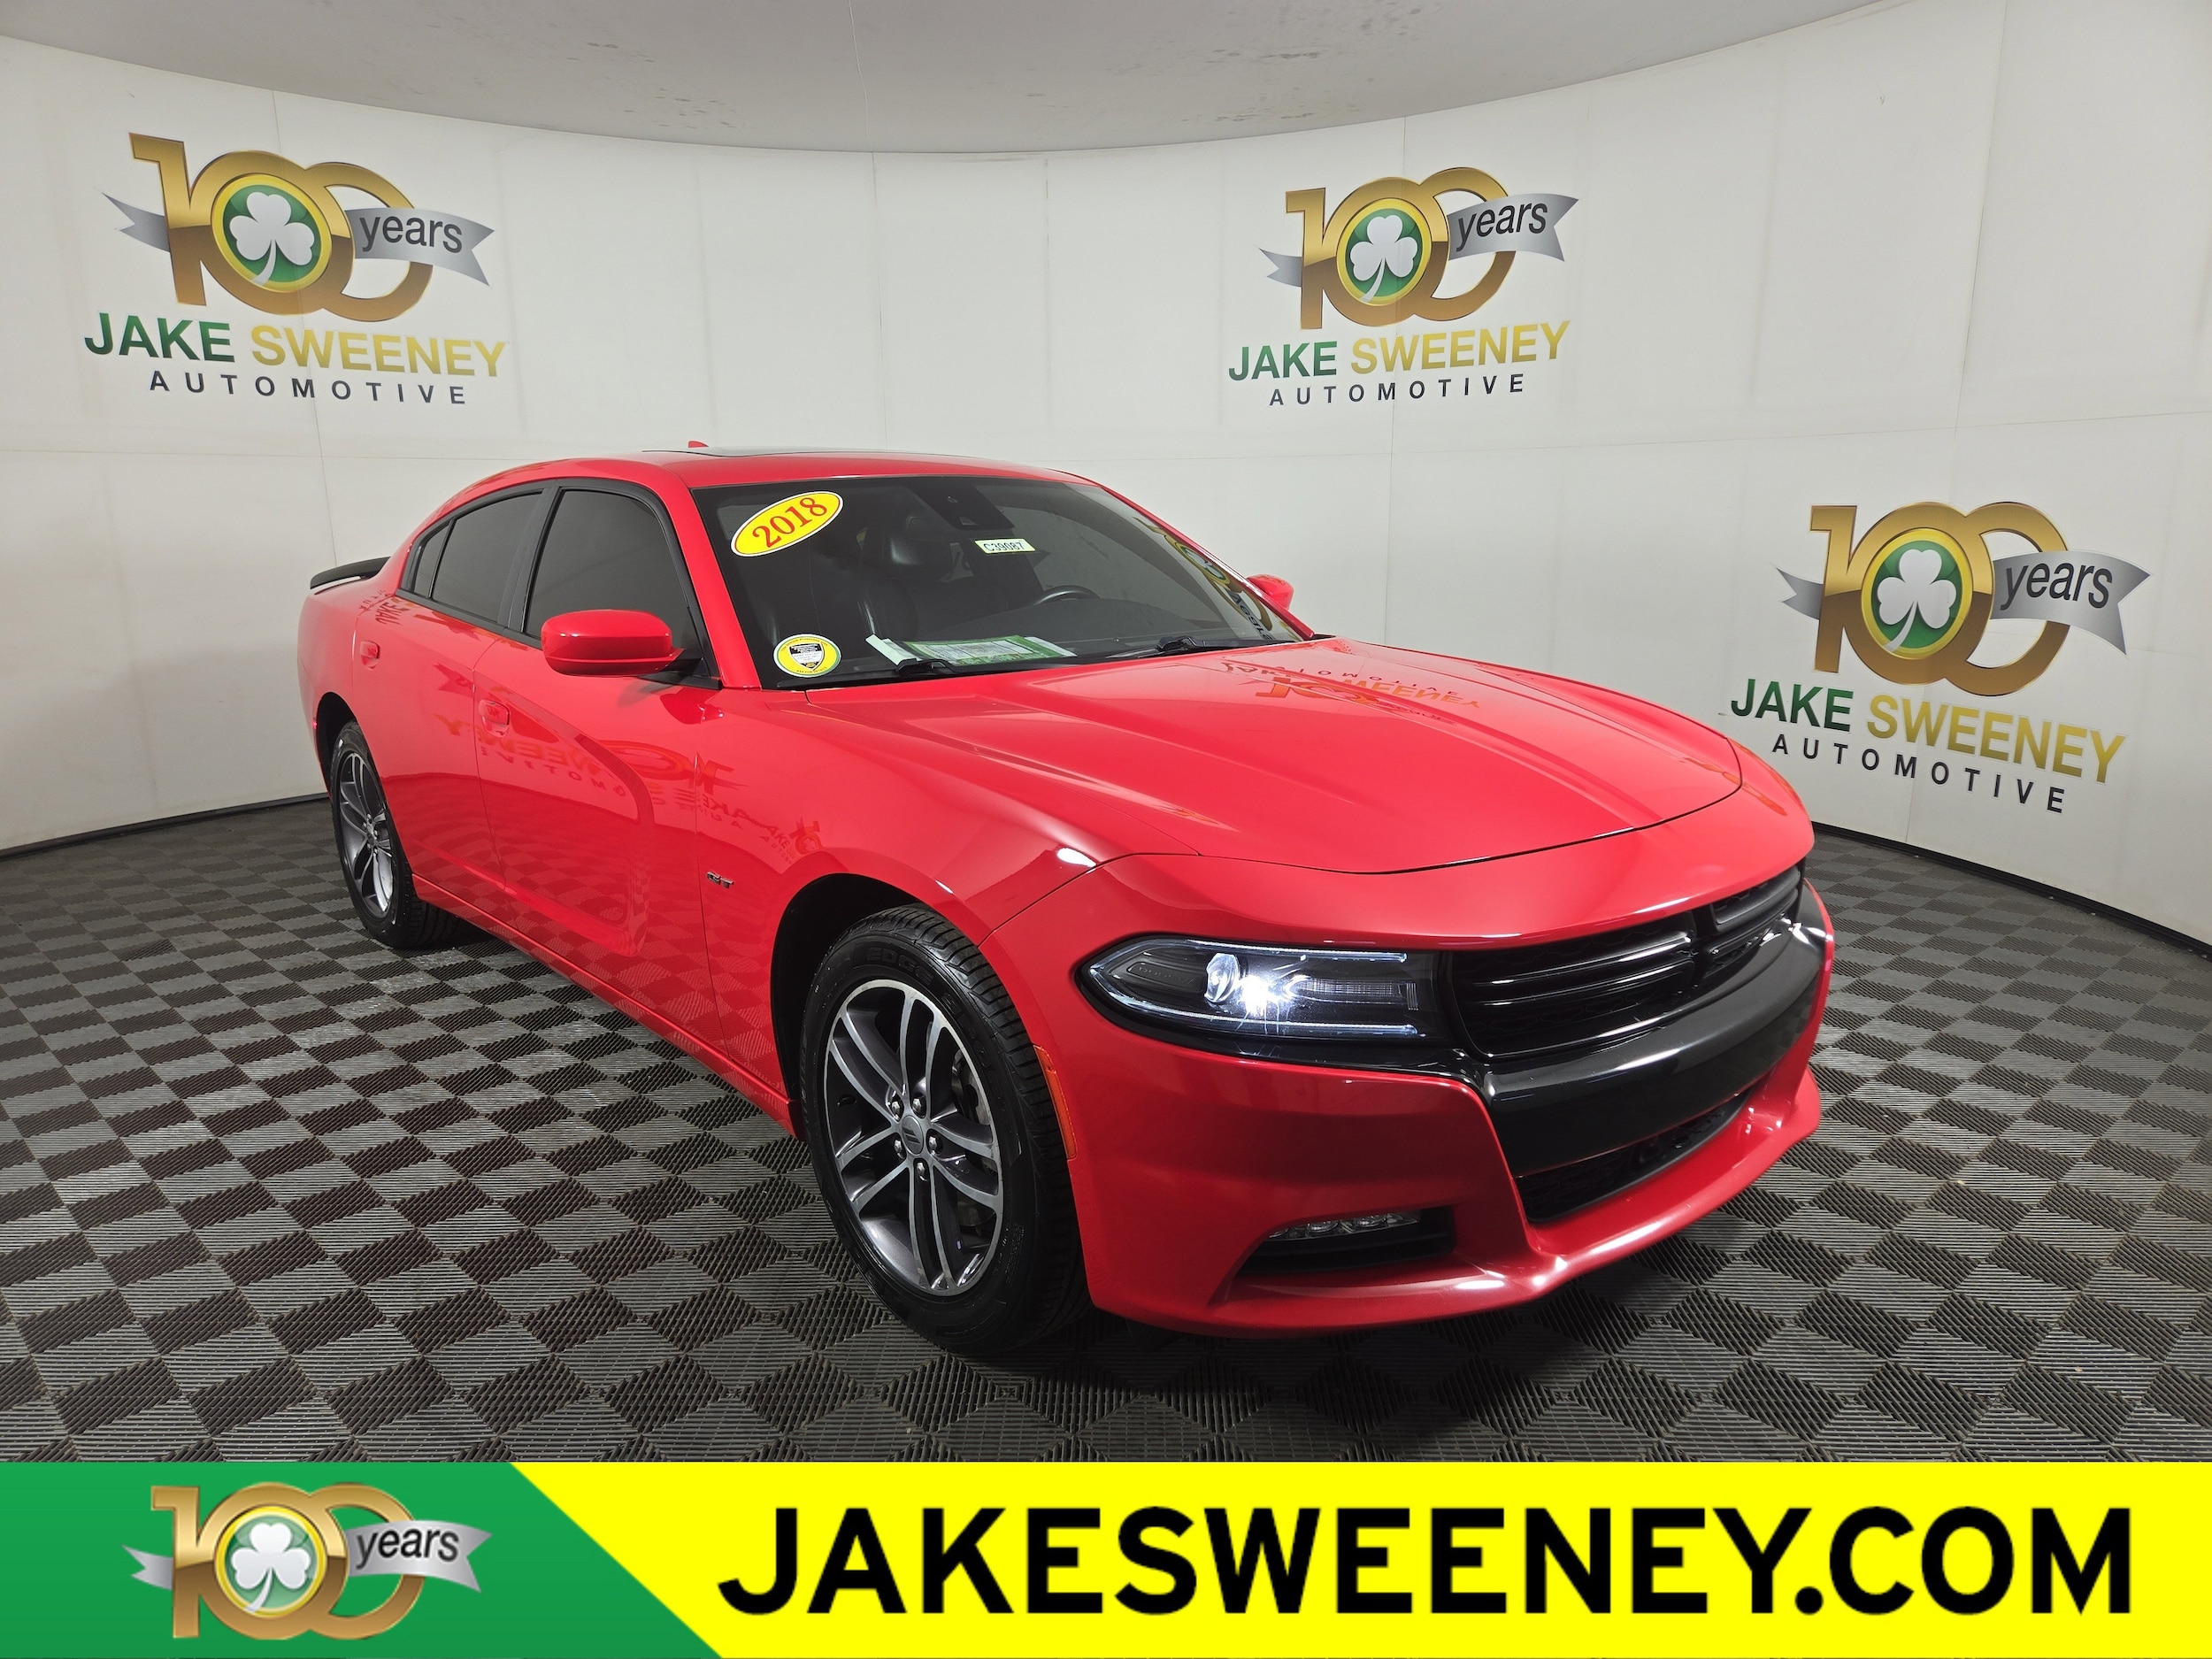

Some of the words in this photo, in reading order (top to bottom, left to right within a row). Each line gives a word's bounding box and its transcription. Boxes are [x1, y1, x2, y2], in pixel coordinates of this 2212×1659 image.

[128, 132, 434, 322] 100
[359, 215, 464, 253] years
[1285, 166, 1516, 330] 100
[1455, 201, 1548, 252] years
[84, 311, 236, 362] JAKE
[250, 324, 505, 378] SWEENEY
[1228, 341, 1338, 381] JAKE
[1350, 320, 1571, 375] SWEENEY
[150, 370, 466, 404] AUTOMOTIVE
[1269, 373, 1525, 406] AUTOMOTIVE
[752, 497, 827, 548] 2018
[983, 542, 1025, 551] C39087
[1809, 501, 2070, 697] 100
[2000, 562, 2113, 611] years
[1731, 678, 1855, 732] JAKE
[1866, 695, 2126, 785] SWEENEY
[1771, 733, 2065, 814] AUTOMOTIVE
